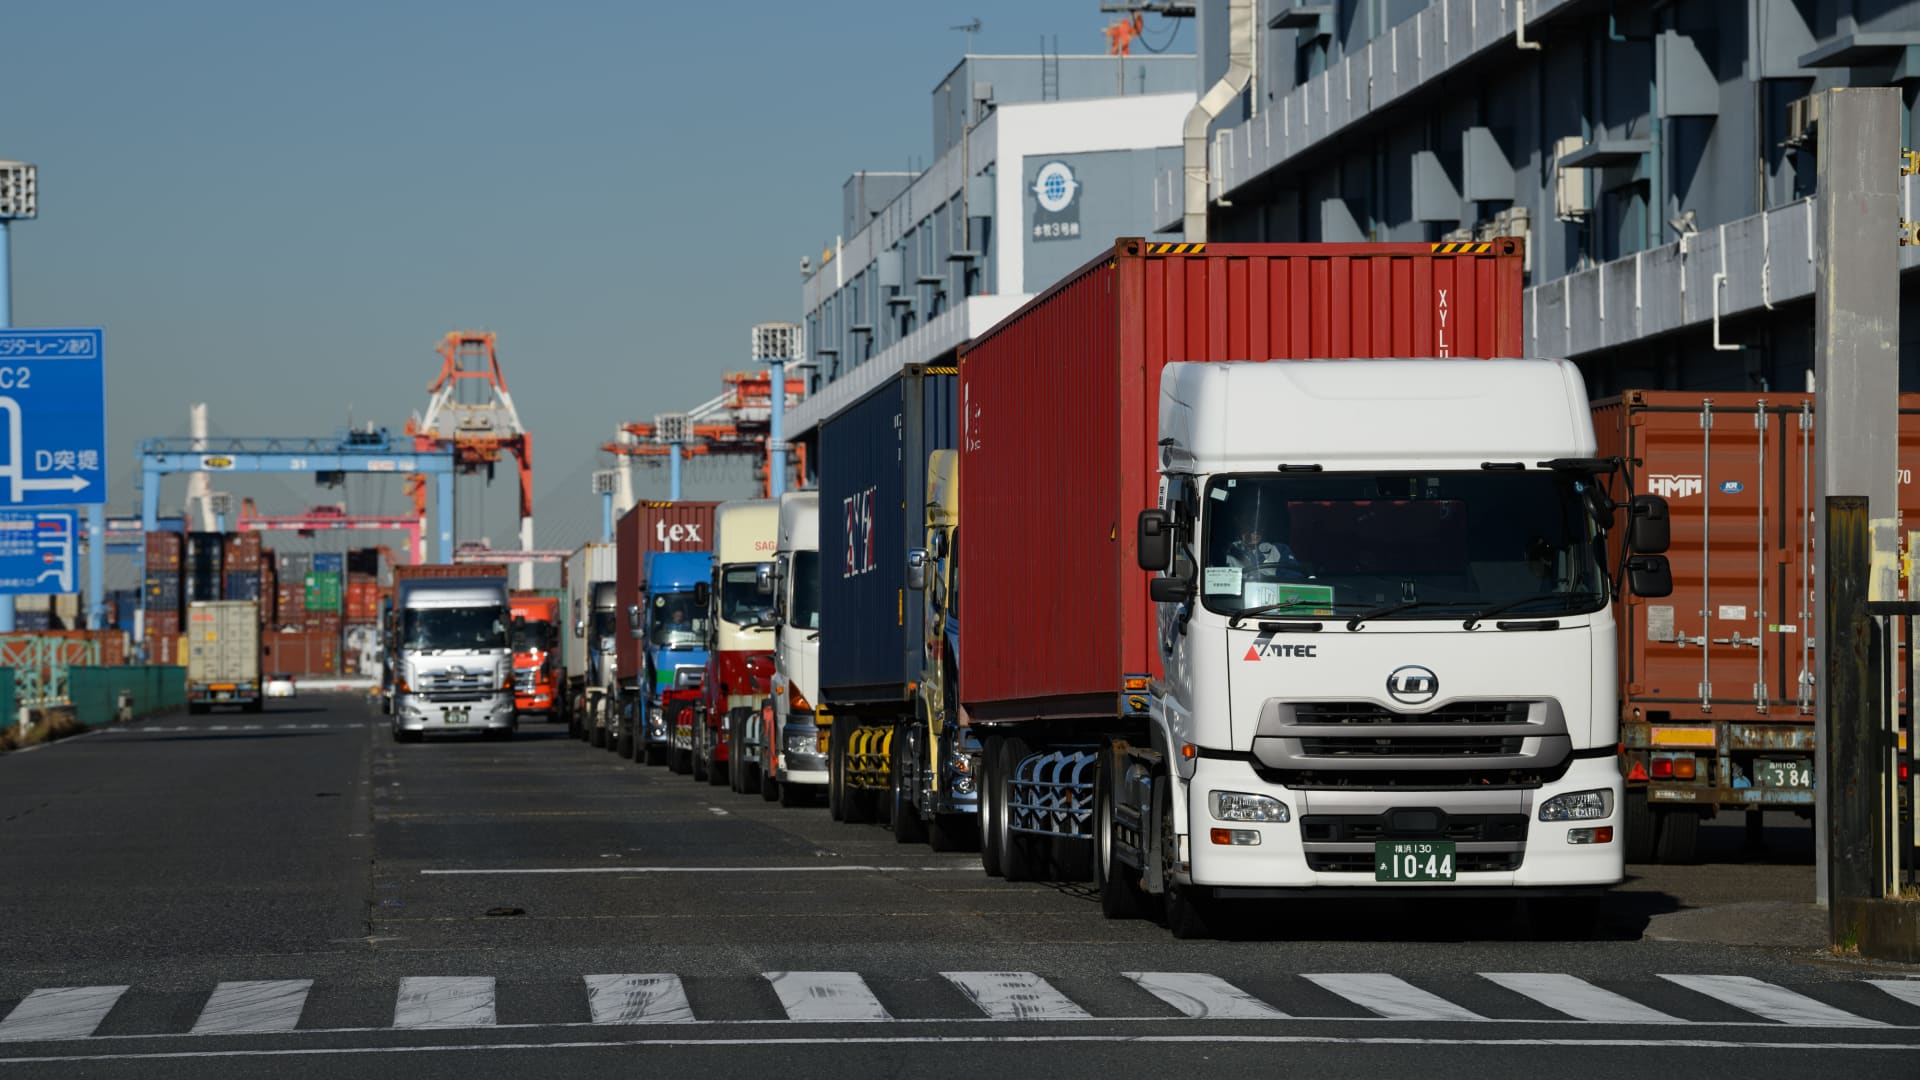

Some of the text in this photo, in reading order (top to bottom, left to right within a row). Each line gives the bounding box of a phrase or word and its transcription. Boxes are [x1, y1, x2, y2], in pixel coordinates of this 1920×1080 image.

[35, 449, 99, 471] D突堤
[1648, 474, 1702, 498] HMM
[656, 518, 702, 543] tex
[754, 540, 777, 552] SAG
[1391, 676, 1434, 694] UD
[1414, 844, 1432, 853] 130
[1393, 854, 1452, 878] 10-44
